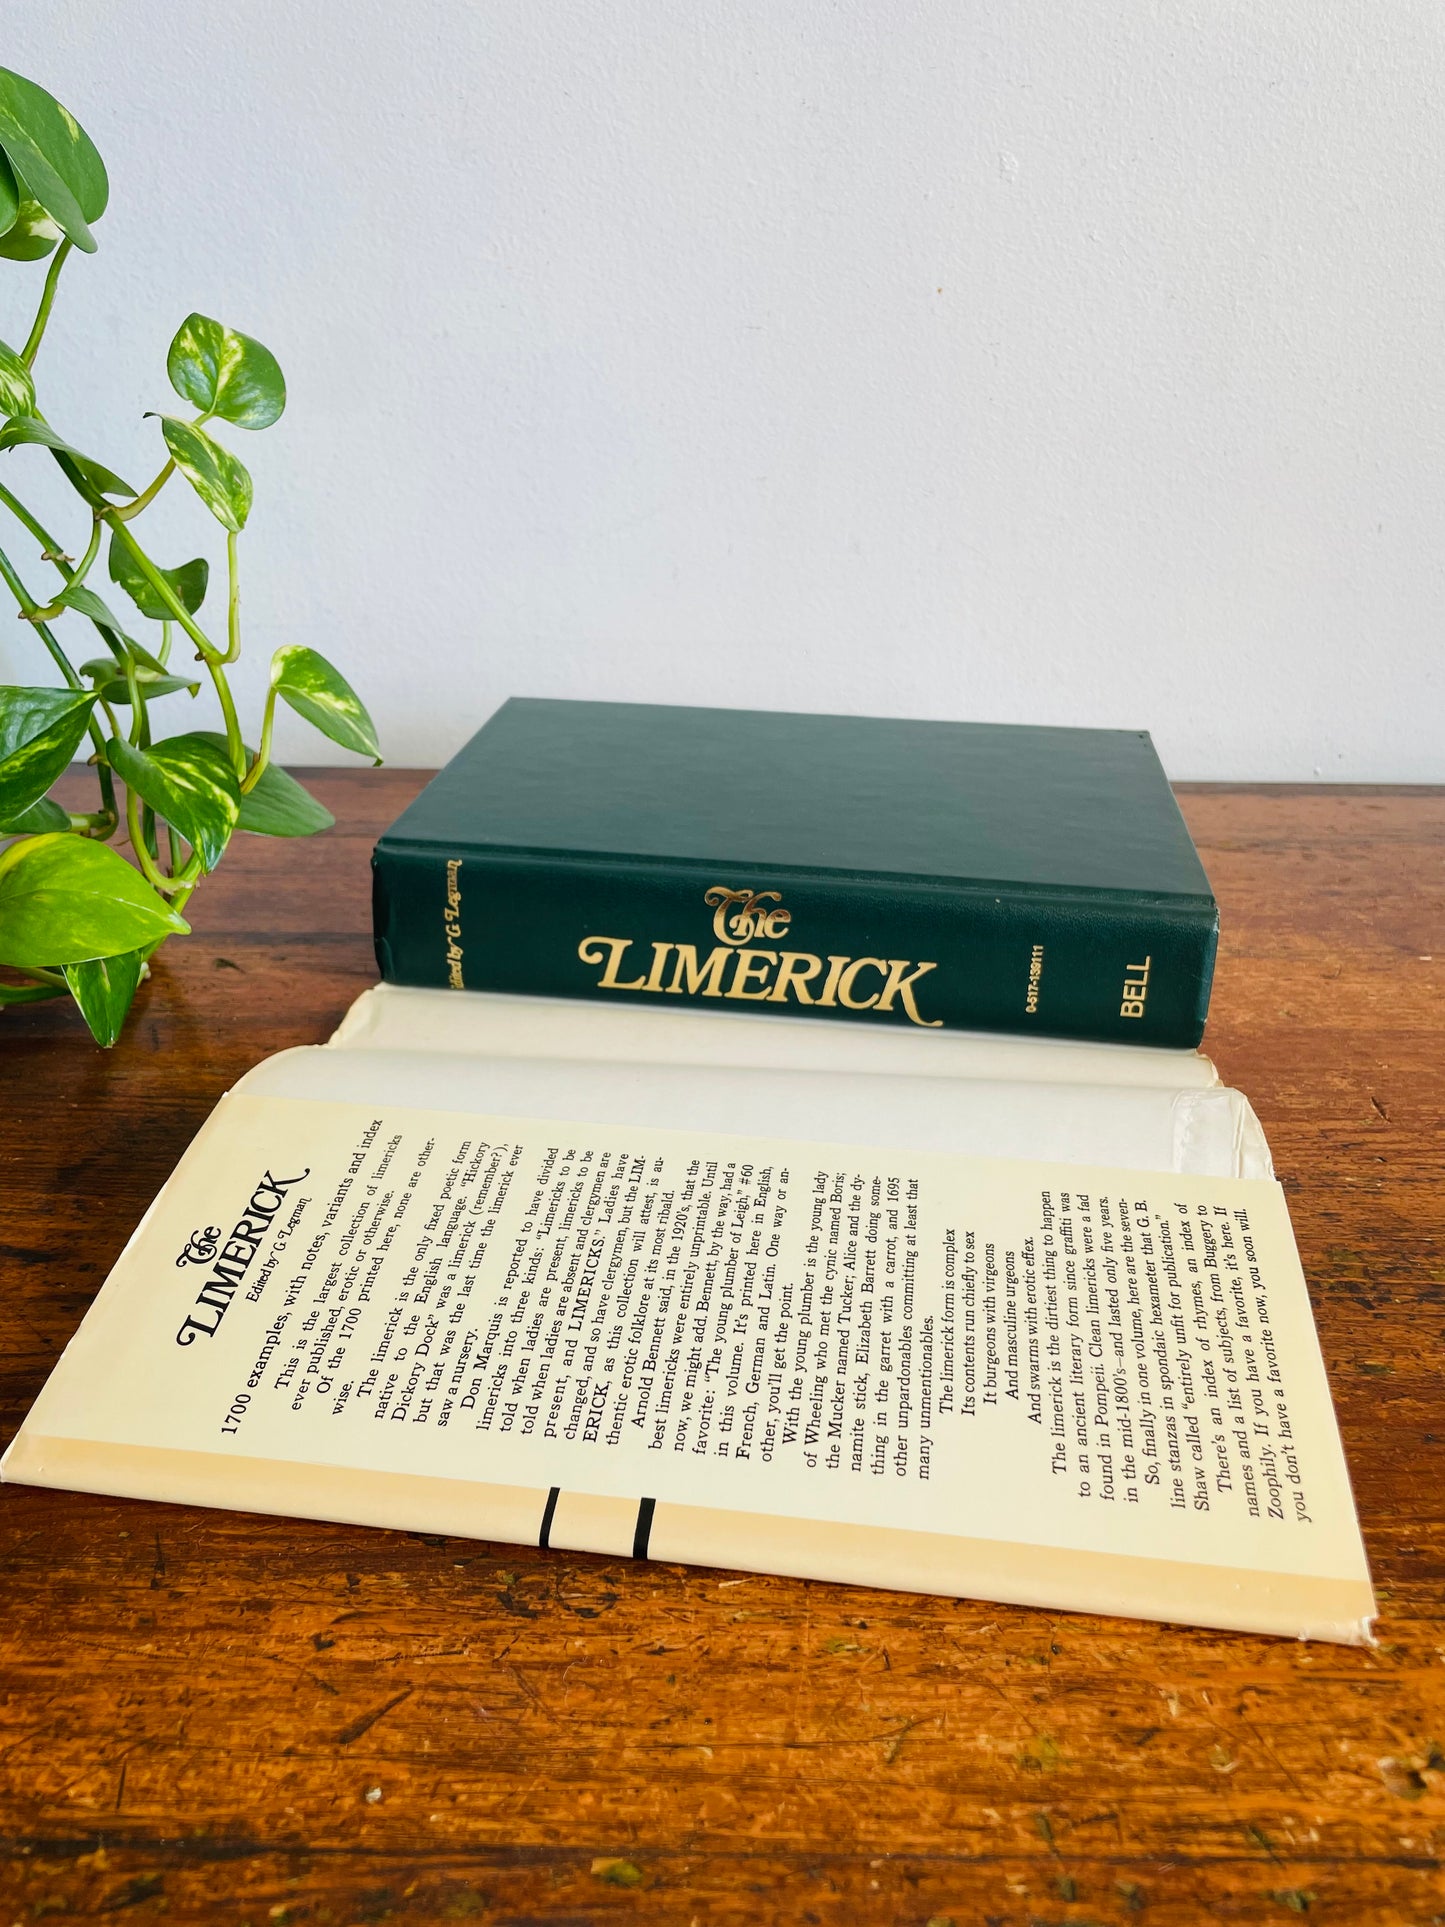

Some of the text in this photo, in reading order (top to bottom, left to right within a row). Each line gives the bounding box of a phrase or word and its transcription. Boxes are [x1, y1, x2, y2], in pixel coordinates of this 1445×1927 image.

[578, 936, 944, 1027] LIMERICK
[704, 886, 792, 945] The
[1120, 955, 1151, 1018] BELL
[175, 1226, 222, 1268] The
[176, 1168, 311, 1346] LIMERICK
[220, 1119, 384, 1435] 1700 examples, with notes, variants and index
[245, 1268, 272, 1303] Edited
[262, 1251, 280, 1269] by
[277, 1197, 312, 1240] Legman
[273, 1134, 403, 1390] This is the largest collection of limericks
[355, 1140, 472, 1398] The limerick is the only fixed poetic form
[459, 1147, 560, 1411] Don Marquis is reported to have divided
[519, 1151, 612, 1436] told when ladies are absent and clergymen are
[562, 1154, 647, 1440] changed, and so have clergymen, but the LIM-
[604, 1190, 676, 1446] thentic erotic folklore at its most ribald.
[647, 1161, 719, 1450] best limericks were entirely unprintable. Until
[734, 1167, 790, 1461] French, German and Latin. One way or an-
[869, 1176, 901, 1476] thing in the garret with a carrot, and 1695
[892, 1178, 919, 1477] other unpardonables committing at least that
[938, 1228, 959, 1415] The limerick form is complex
[960, 1230, 979, 1417] Its contents run chiefly to sex
[981, 1242, 1001, 1406] It burgeons with virgeons
[1020, 1236, 1042, 1425] And swarms with erotic effex.
[1058, 1192, 1092, 1498] to an ancient literary form since graffiti was
[1118, 1197, 1162, 1485] So, finally in one volume, here are the seven-
[1134, 1199, 1186, 1509] line stanzas in spondaic hexameter that G. B.
[1196, 1204, 1261, 1518] names and a list of subjects, from Buggery to
